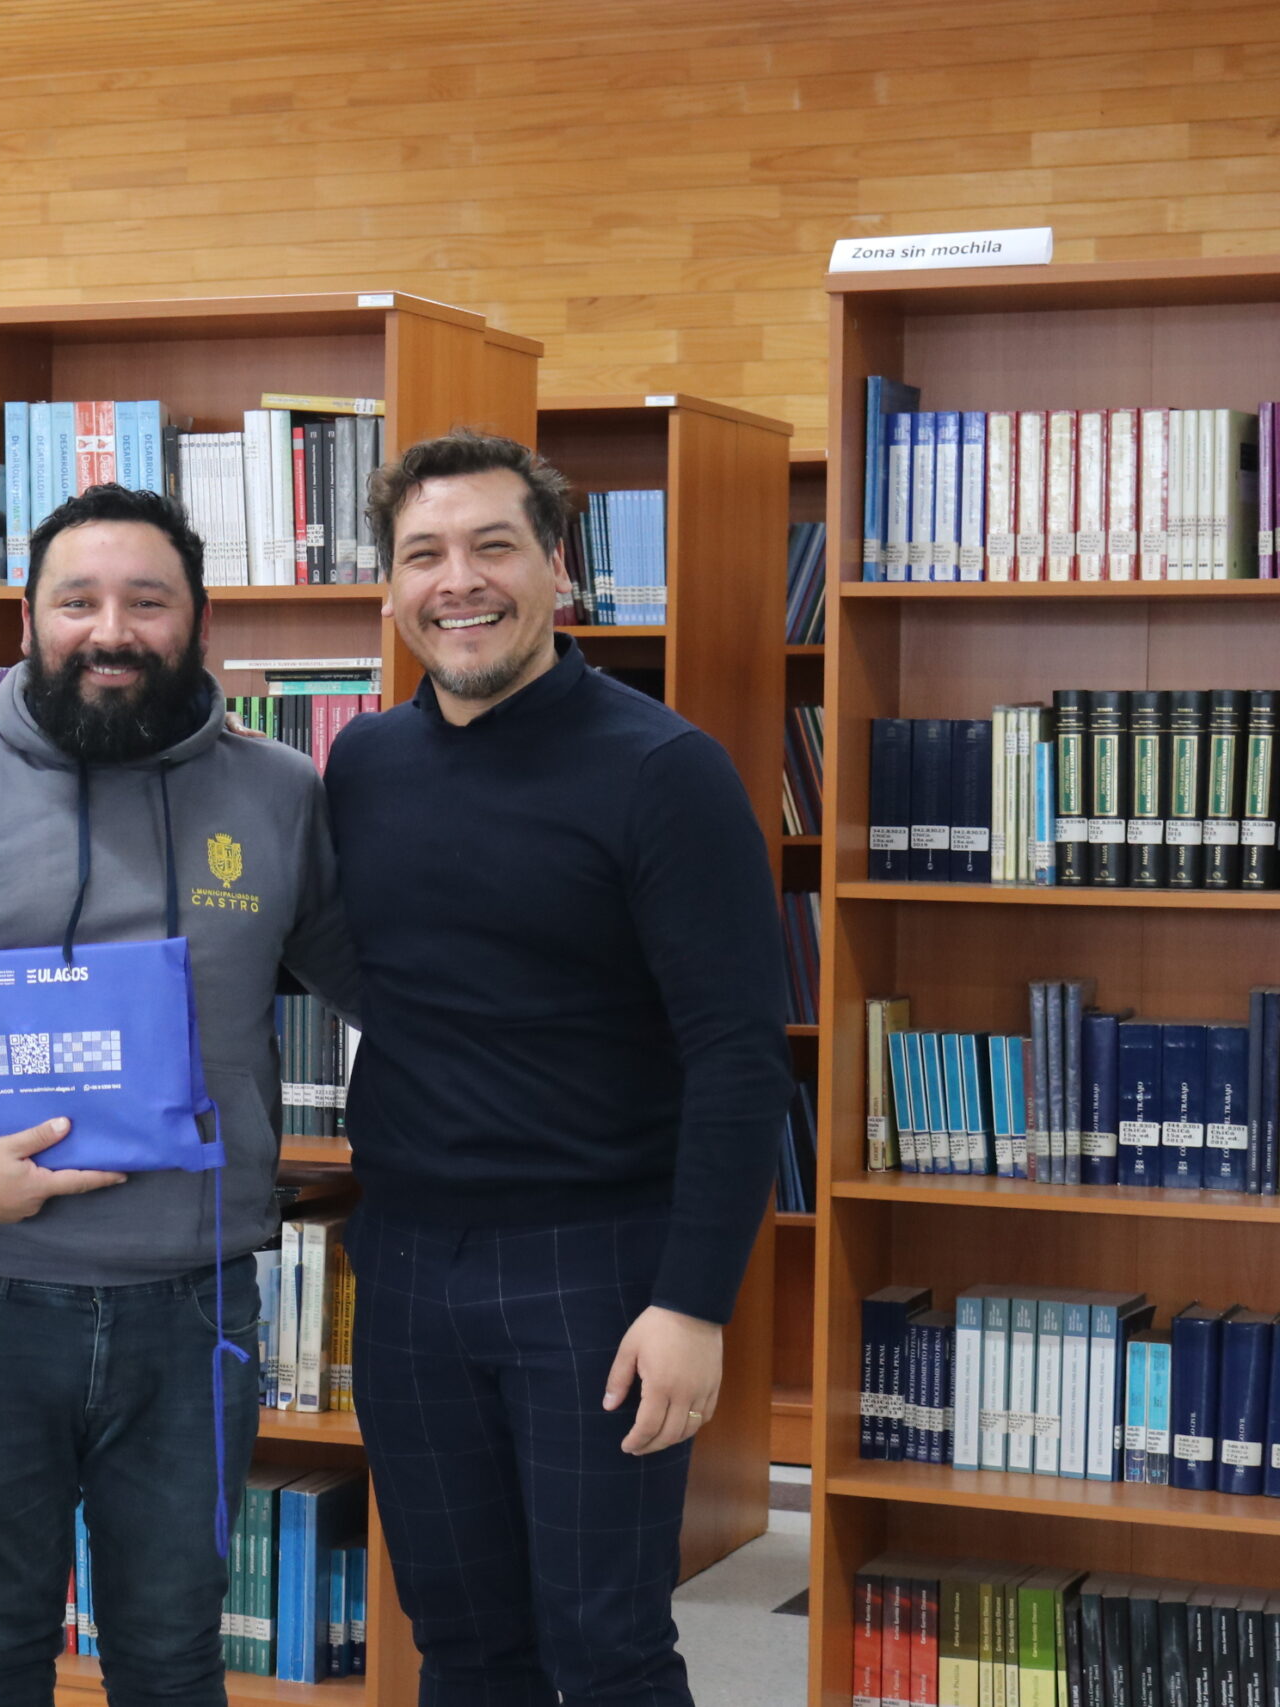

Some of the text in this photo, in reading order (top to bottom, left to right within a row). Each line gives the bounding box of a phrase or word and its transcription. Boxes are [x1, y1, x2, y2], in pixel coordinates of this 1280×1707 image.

[851, 240, 1003, 259] Zona sin mochila
[37, 435, 46, 490] DESARROLLO
[59, 433, 69, 488] DESARROLLO
[122, 434, 131, 490] DESARROLLO
[144, 434, 154, 490] DESARROLLO
[191, 894, 259, 913] CASTRO
[38, 967, 89, 983] ULAGOS
[1092, 1083, 1100, 1110] TRABAJO
[1136, 1081, 1145, 1112] TRABAJO
[1180, 1082, 1189, 1113] TRABAJO
[1223, 1083, 1232, 1114] TRABAJO
[934, 1330, 942, 1352] PENAL
[920, 1350, 928, 1406] PROCEDIMIENTO
